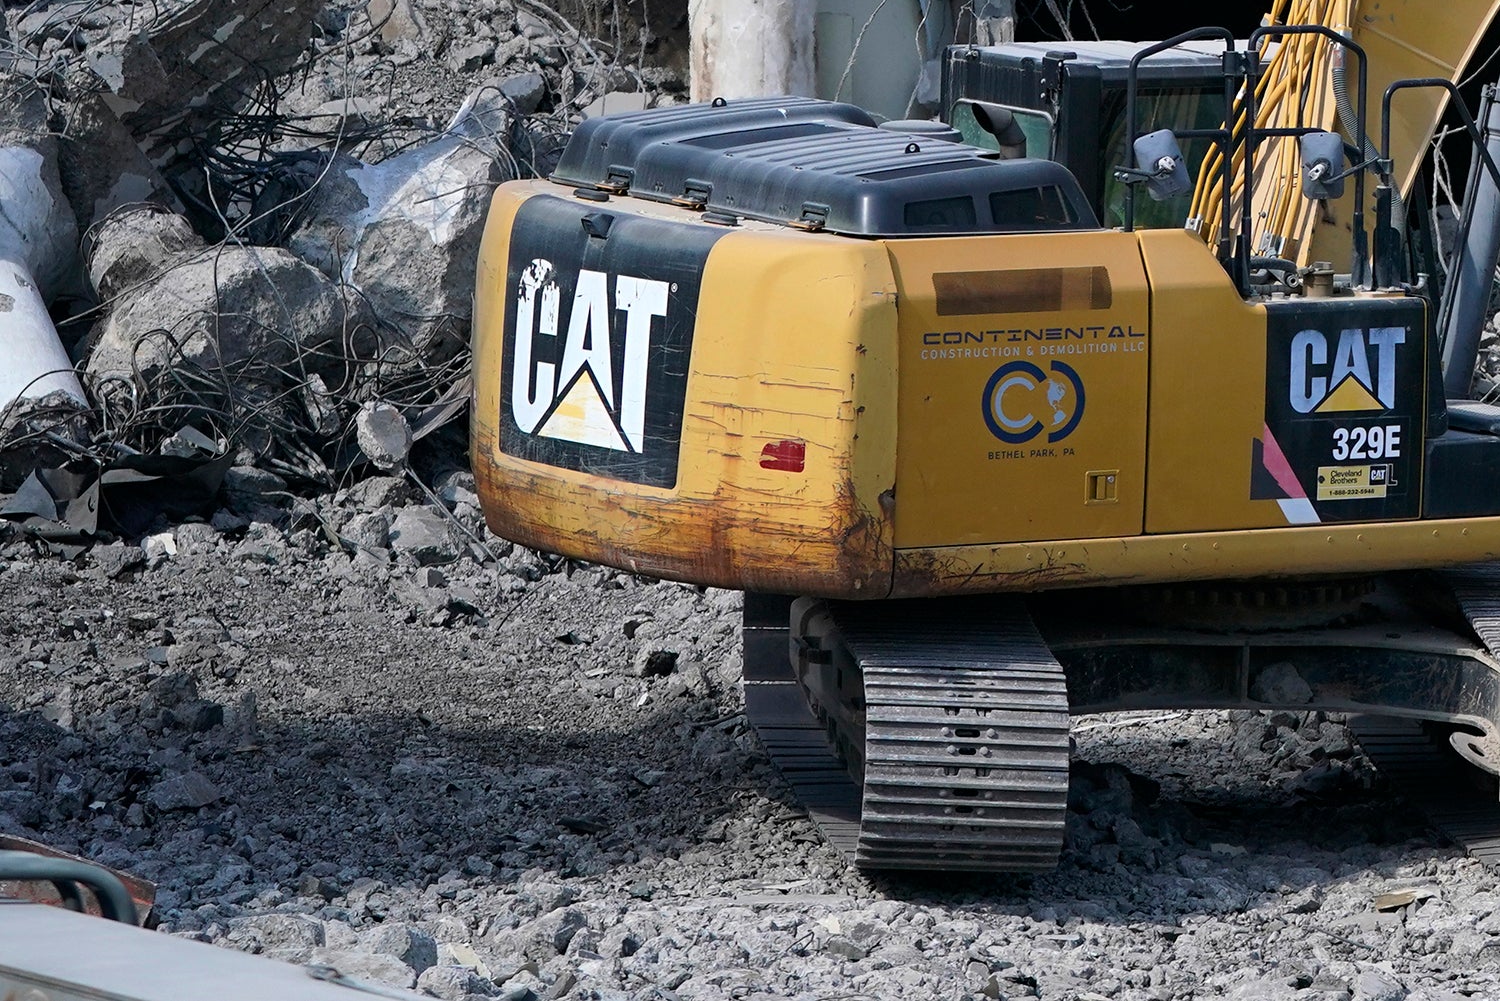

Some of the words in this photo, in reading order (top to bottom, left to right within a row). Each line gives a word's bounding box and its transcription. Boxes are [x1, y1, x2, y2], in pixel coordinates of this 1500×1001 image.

[923, 325, 1146, 345] CONTINENTAL
[920, 347, 1020, 360] CONSTRUCTION
[1026, 345, 1035, 356] &
[1040, 343, 1117, 356] DEMOLITION
[1123, 341, 1146, 352] LLC
[1290, 327, 1405, 413] CAT
[1332, 424, 1401, 461] 329E
[988, 450, 1025, 460] BETHEL
[1063, 448, 1075, 456] PA
[1330, 469, 1363, 478] Cleveland
[1330, 477, 1358, 485] Brothers
[1371, 469, 1386, 480] CAT
